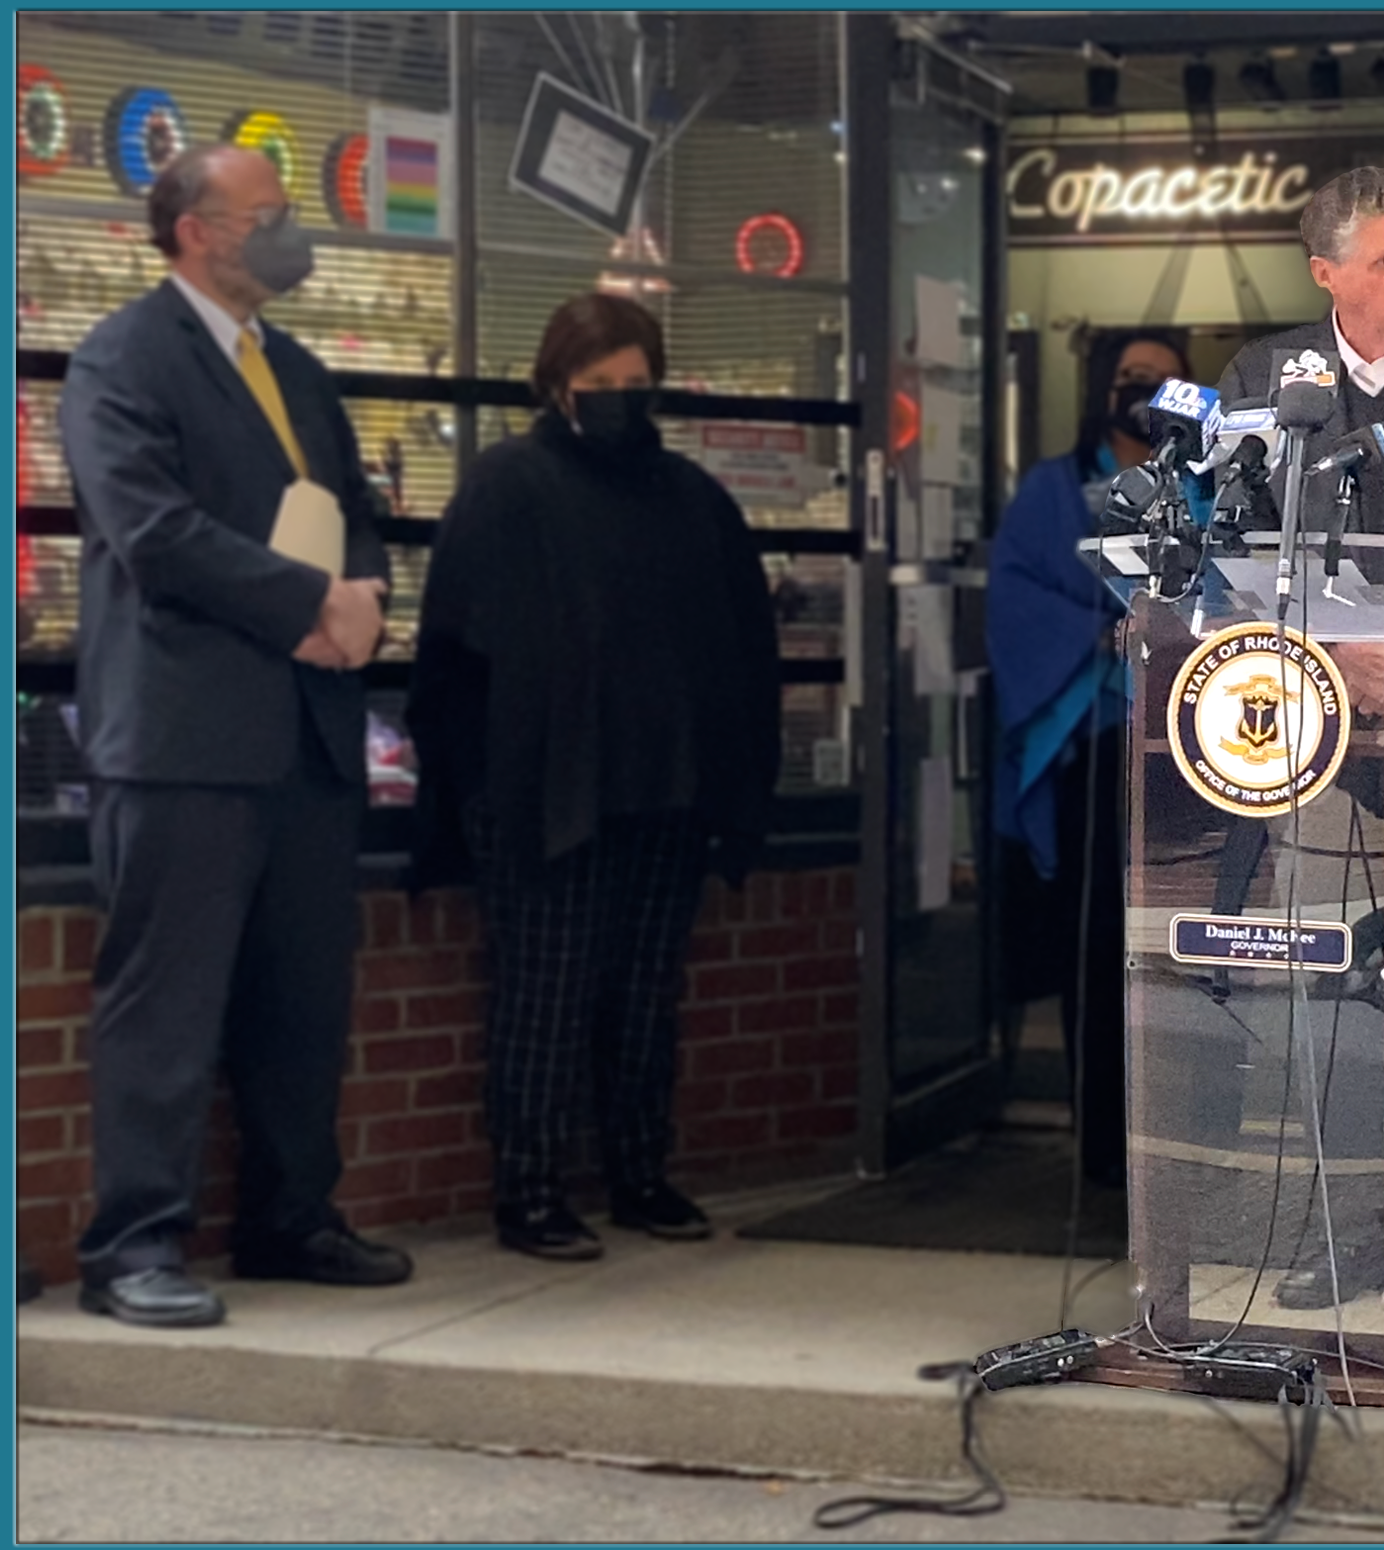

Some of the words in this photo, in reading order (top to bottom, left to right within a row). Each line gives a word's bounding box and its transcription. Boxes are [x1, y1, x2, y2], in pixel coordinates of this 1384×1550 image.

[1005, 149, 1314, 232] Copacetic
[1161, 379, 1200, 404] 10
[1158, 397, 1201, 418] WJAR
[1184, 655, 1218, 704] STATE
[1218, 640, 1240, 660] OF
[1195, 760, 1226, 791] OFFICE
[1225, 784, 1240, 797] OF
[1241, 789, 1262, 801] THE
[1262, 769, 1316, 801] GOVENOR
[1205, 924, 1251, 940] Daniel
[1253, 928, 1265, 941] J.
[1230, 940, 1289, 952] GOVERNOR
